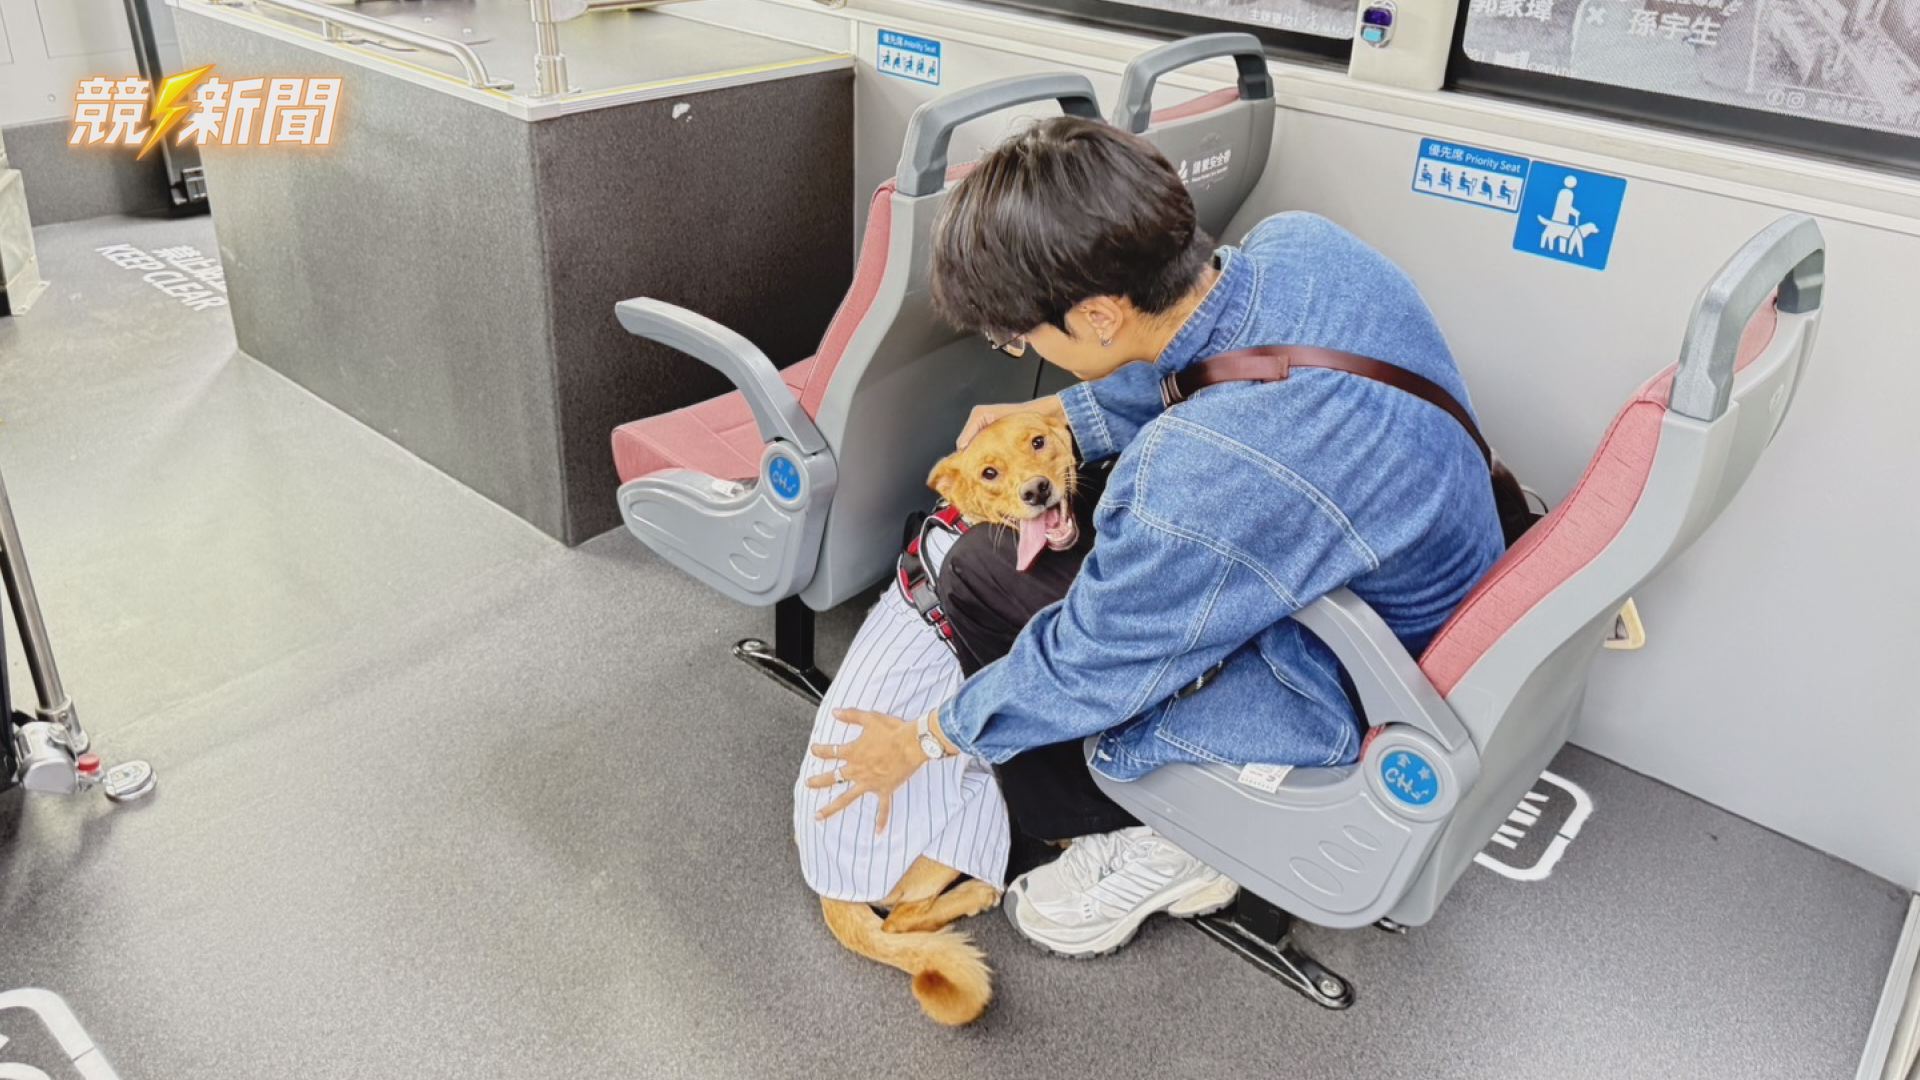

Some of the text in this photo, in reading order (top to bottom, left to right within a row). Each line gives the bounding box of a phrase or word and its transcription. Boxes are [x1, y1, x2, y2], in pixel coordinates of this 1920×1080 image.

[1628, 9, 1721, 46] 孫宇生
[1428, 144, 1520, 173] 優先席 Priority Seat
[94, 243, 228, 311] KEEP CLEAR
